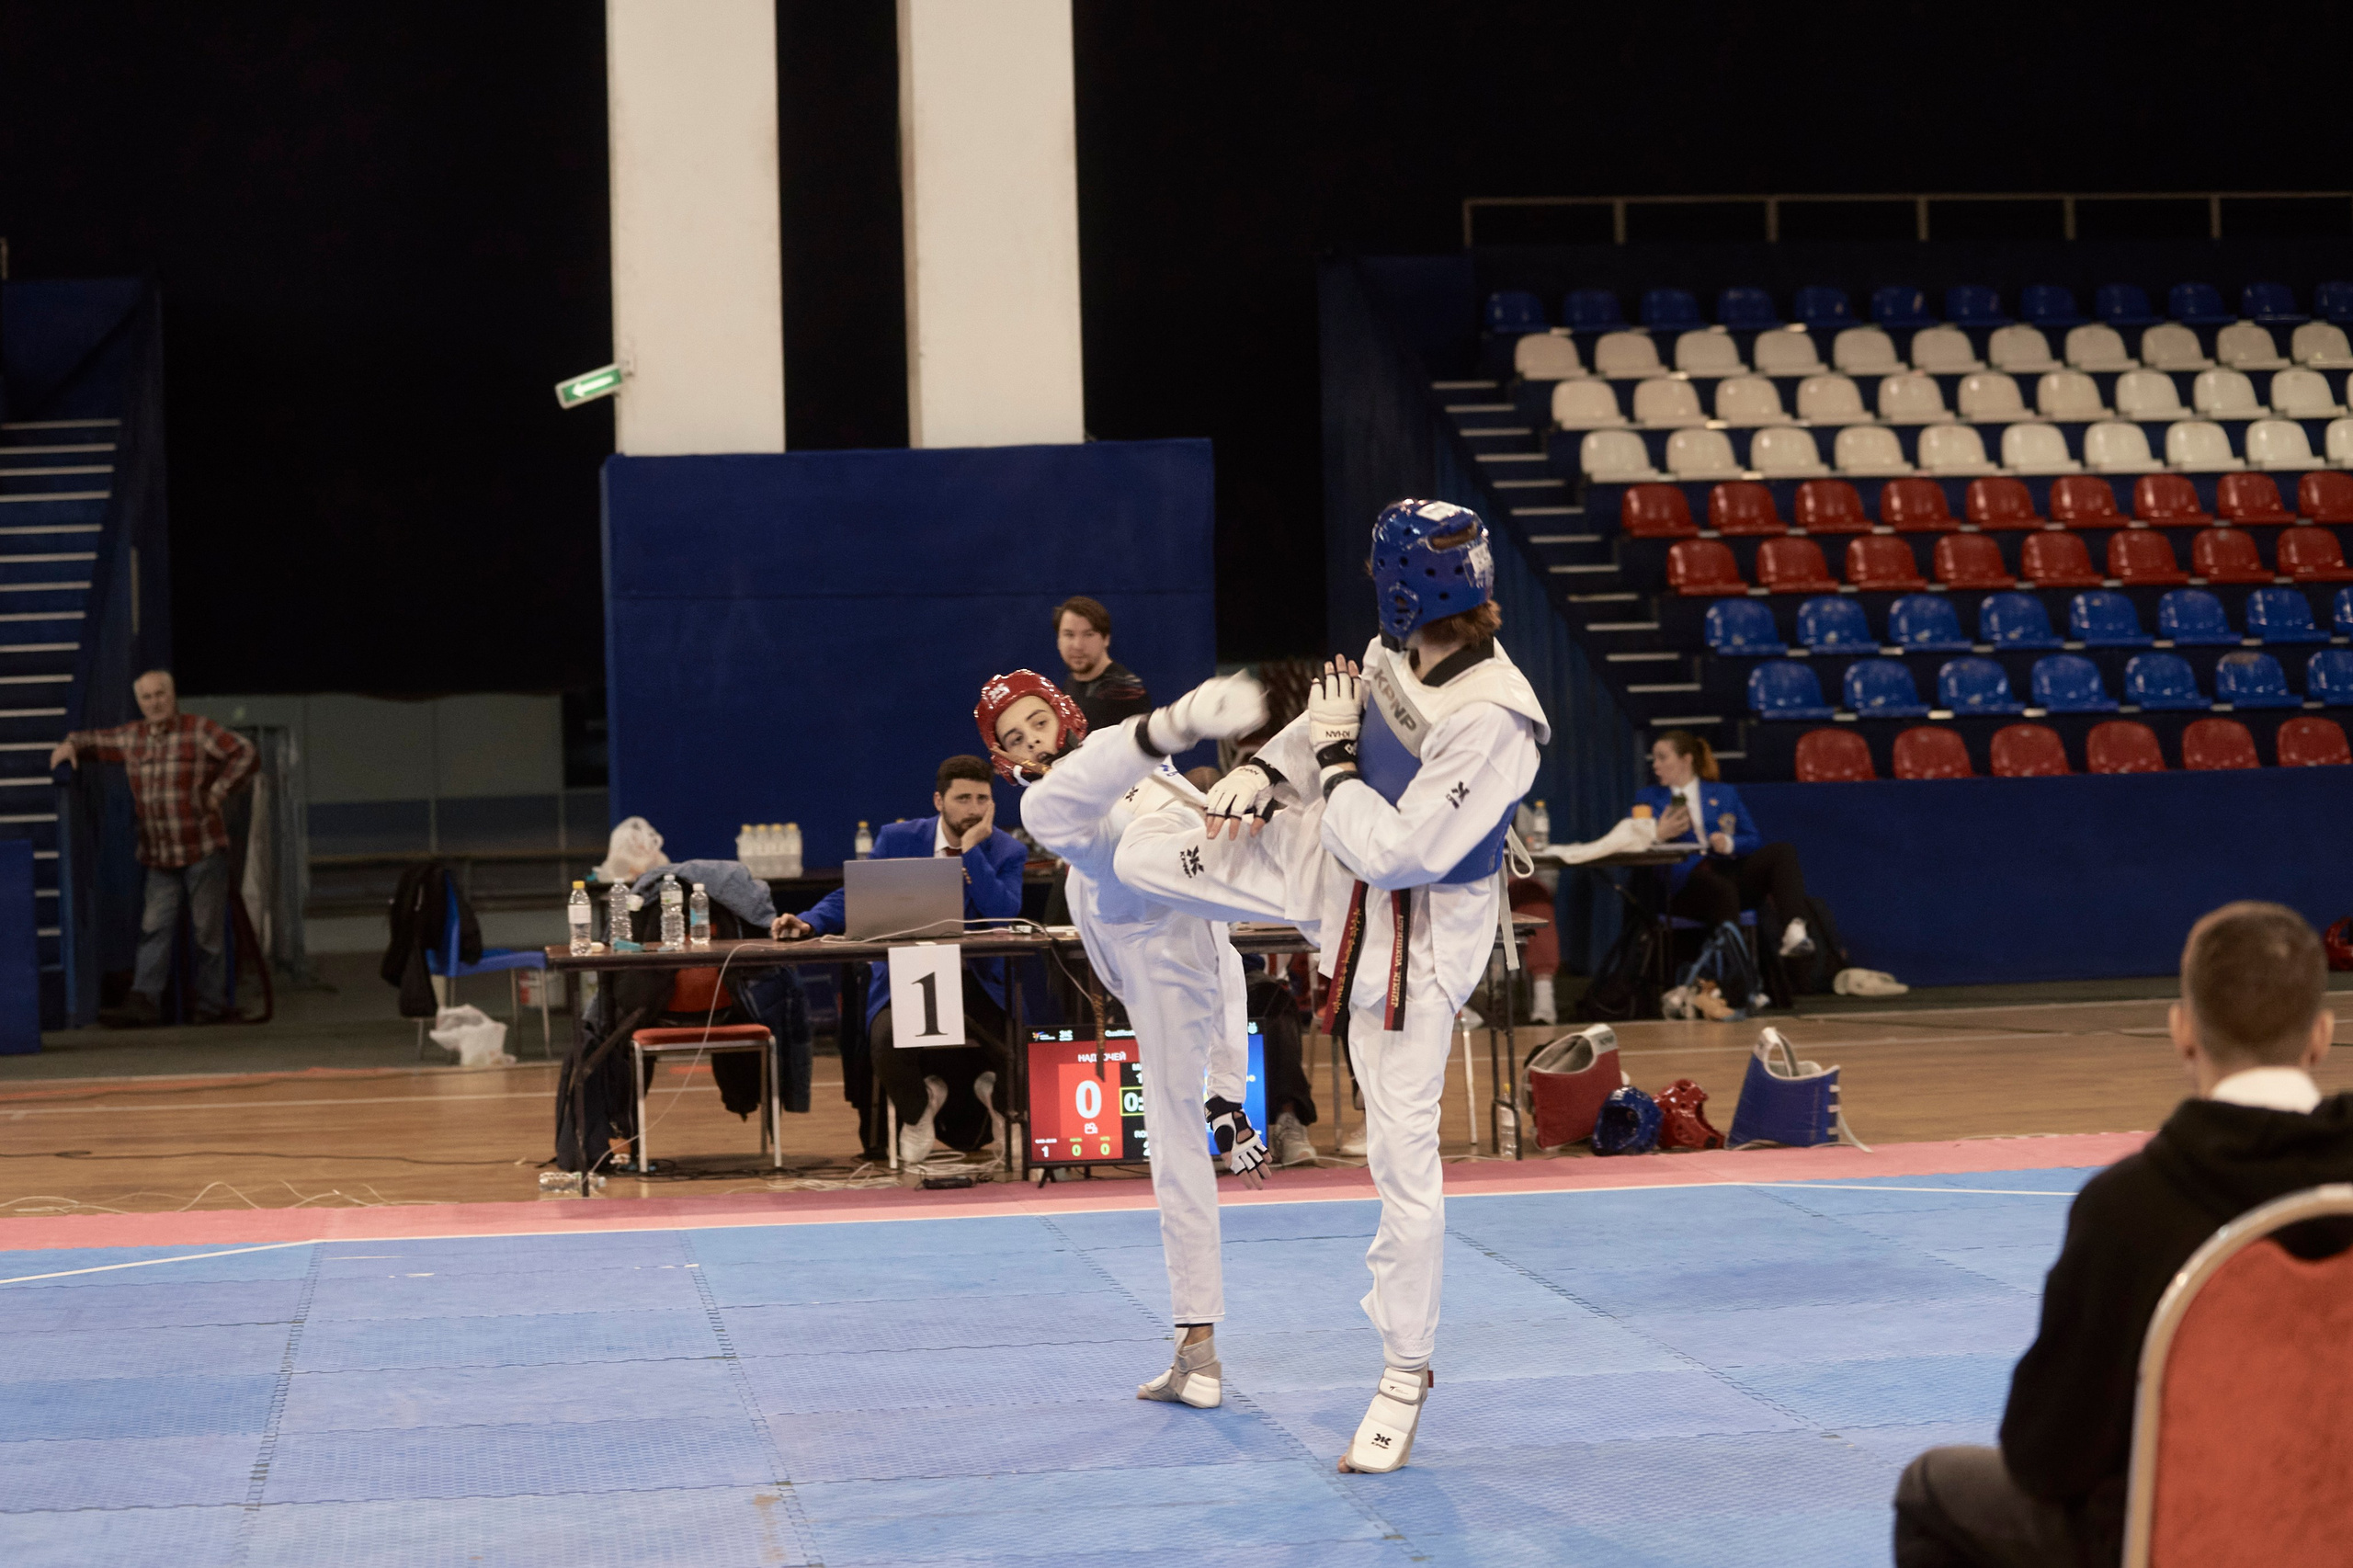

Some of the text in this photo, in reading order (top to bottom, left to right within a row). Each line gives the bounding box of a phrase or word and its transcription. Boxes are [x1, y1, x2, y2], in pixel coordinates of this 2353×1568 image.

[1374, 669, 1416, 732] KPNP
[911, 971, 949, 1037] 1
[1075, 1080, 1102, 1119] 0
[1041, 1145, 1050, 1158] 1
[1072, 1144, 1082, 1156] 0
[1100, 1143, 1110, 1155] 0
